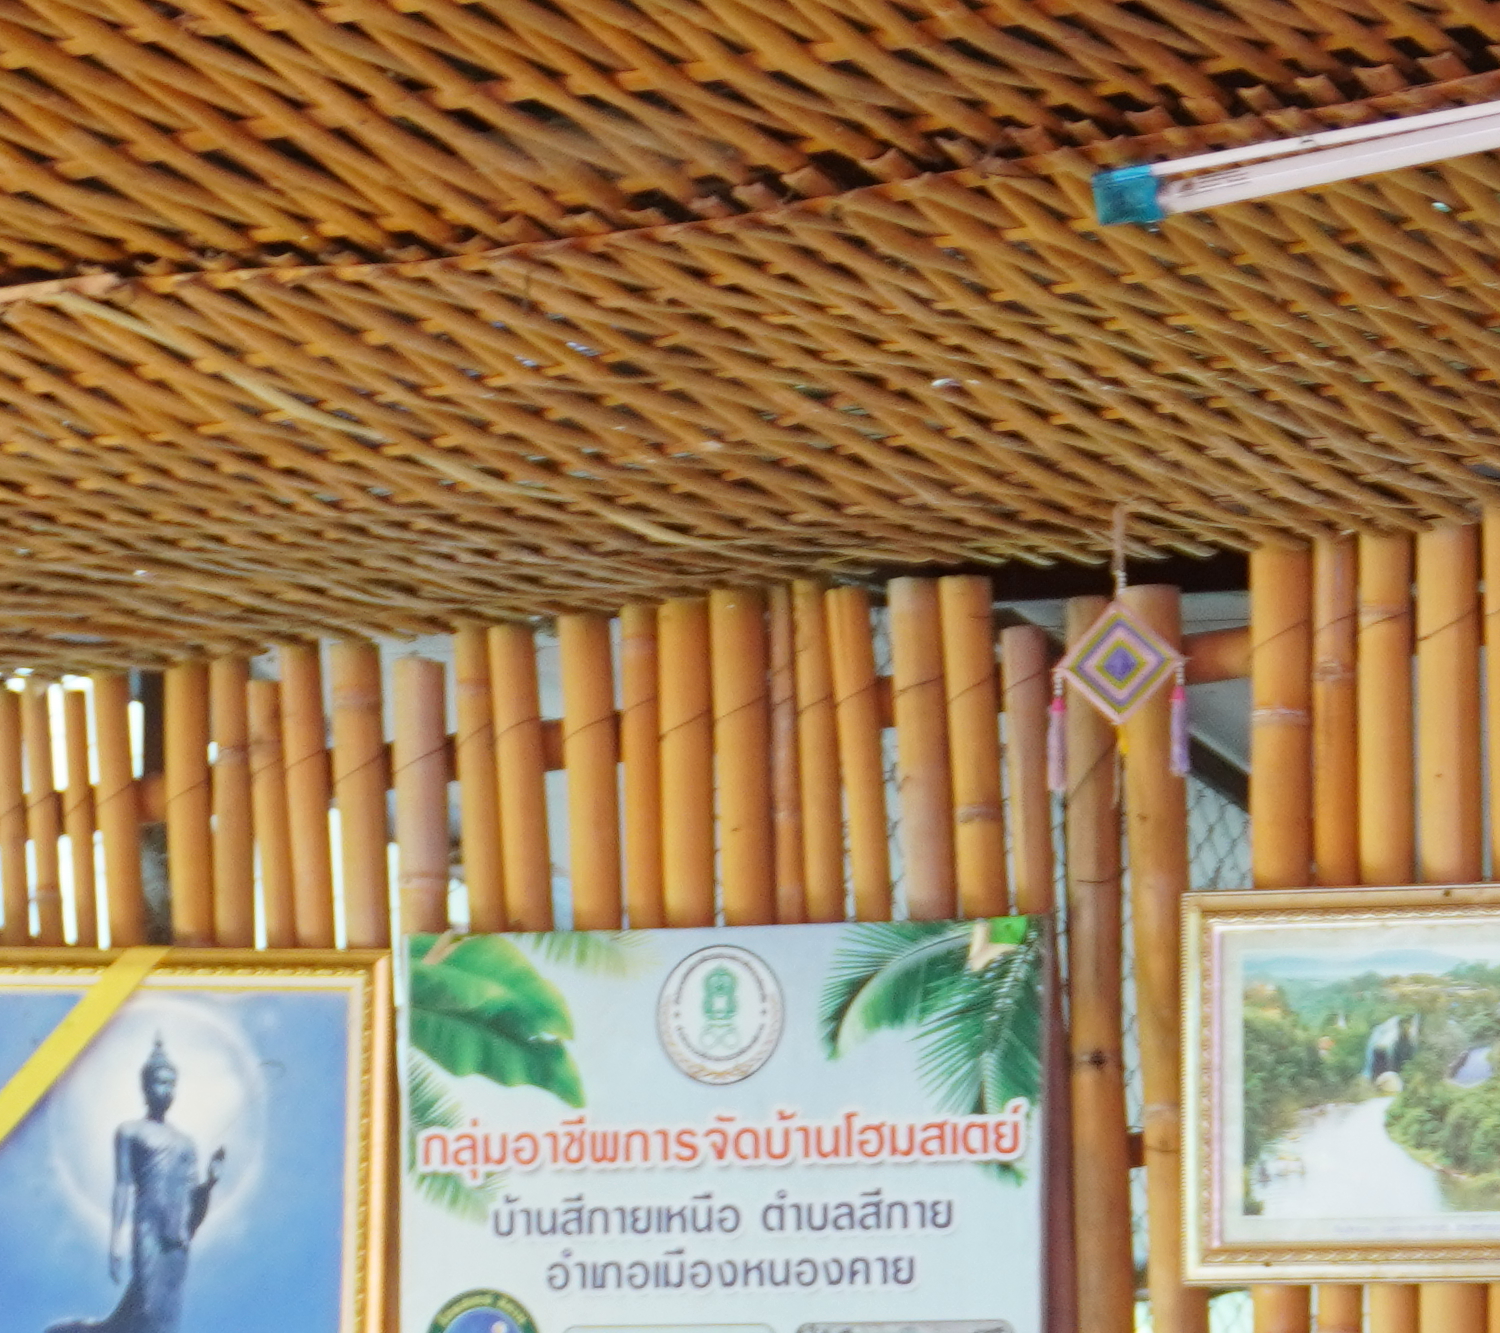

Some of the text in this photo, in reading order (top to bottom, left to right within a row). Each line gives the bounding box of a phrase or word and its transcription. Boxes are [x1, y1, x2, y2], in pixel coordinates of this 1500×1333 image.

[418, 1103, 1021, 1182] กลุ่มอาชีพการจัดบ้านโฮมสเตย์
[493, 1190, 953, 1238] บ้านสีกายเหนือ ตำบลสีกาย
[547, 1250, 915, 1291] อำเภอเมืองหนองคาย
